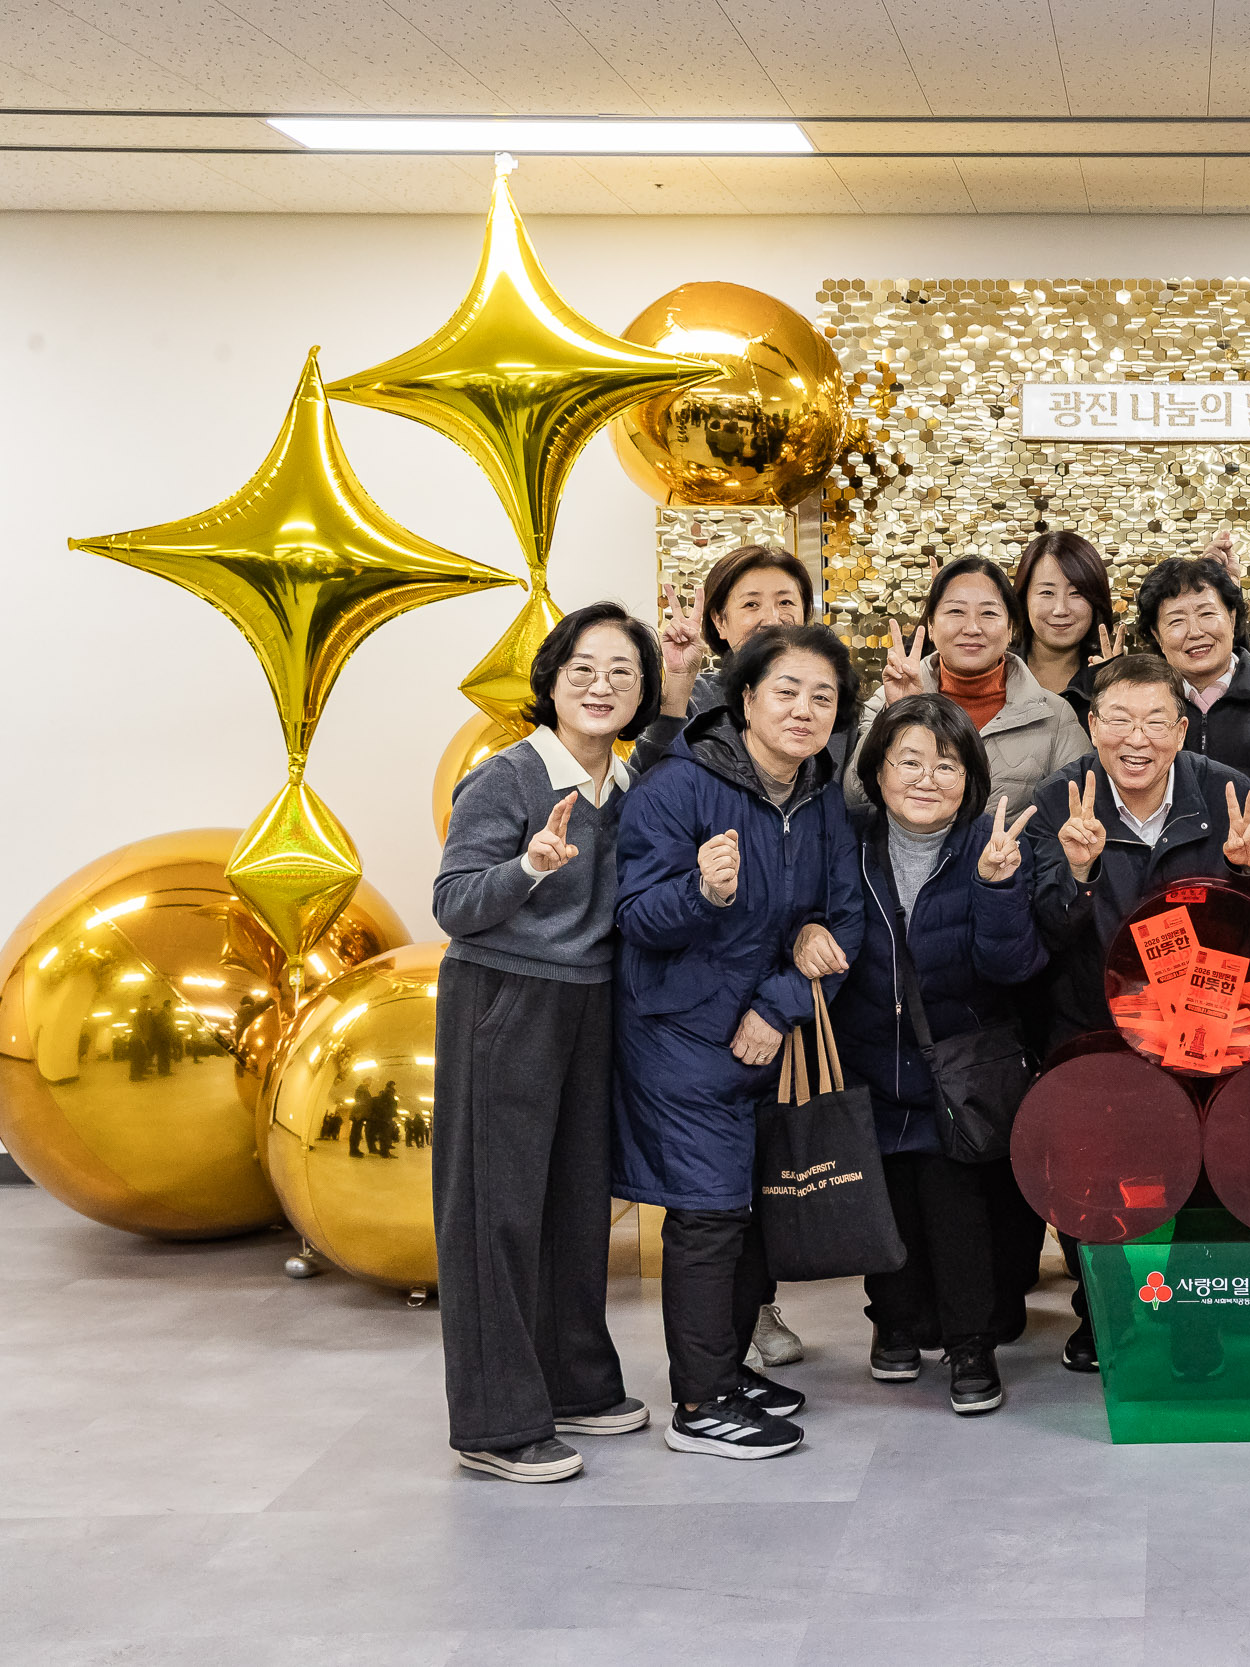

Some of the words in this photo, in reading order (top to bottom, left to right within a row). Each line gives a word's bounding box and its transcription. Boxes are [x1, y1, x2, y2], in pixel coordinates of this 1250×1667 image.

[1049, 391, 1119, 427] 광진
[1130, 391, 1232, 427] 나눔의
[1143, 936, 1161, 948] 2026
[1145, 934, 1191, 961] 따뜻한
[1193, 966, 1211, 976] 2026
[1190, 973, 1236, 996] 따뜻한
[781, 1170, 796, 1180] SEJ
[795, 1160, 836, 1182] UNIVERSITY
[762, 1186, 797, 1196] GRADUATE
[796, 1183, 818, 1198] HOOL
[818, 1179, 828, 1189] OF
[829, 1171, 863, 1186] TOURISM
[1176, 1277, 1228, 1297] 사랑의
